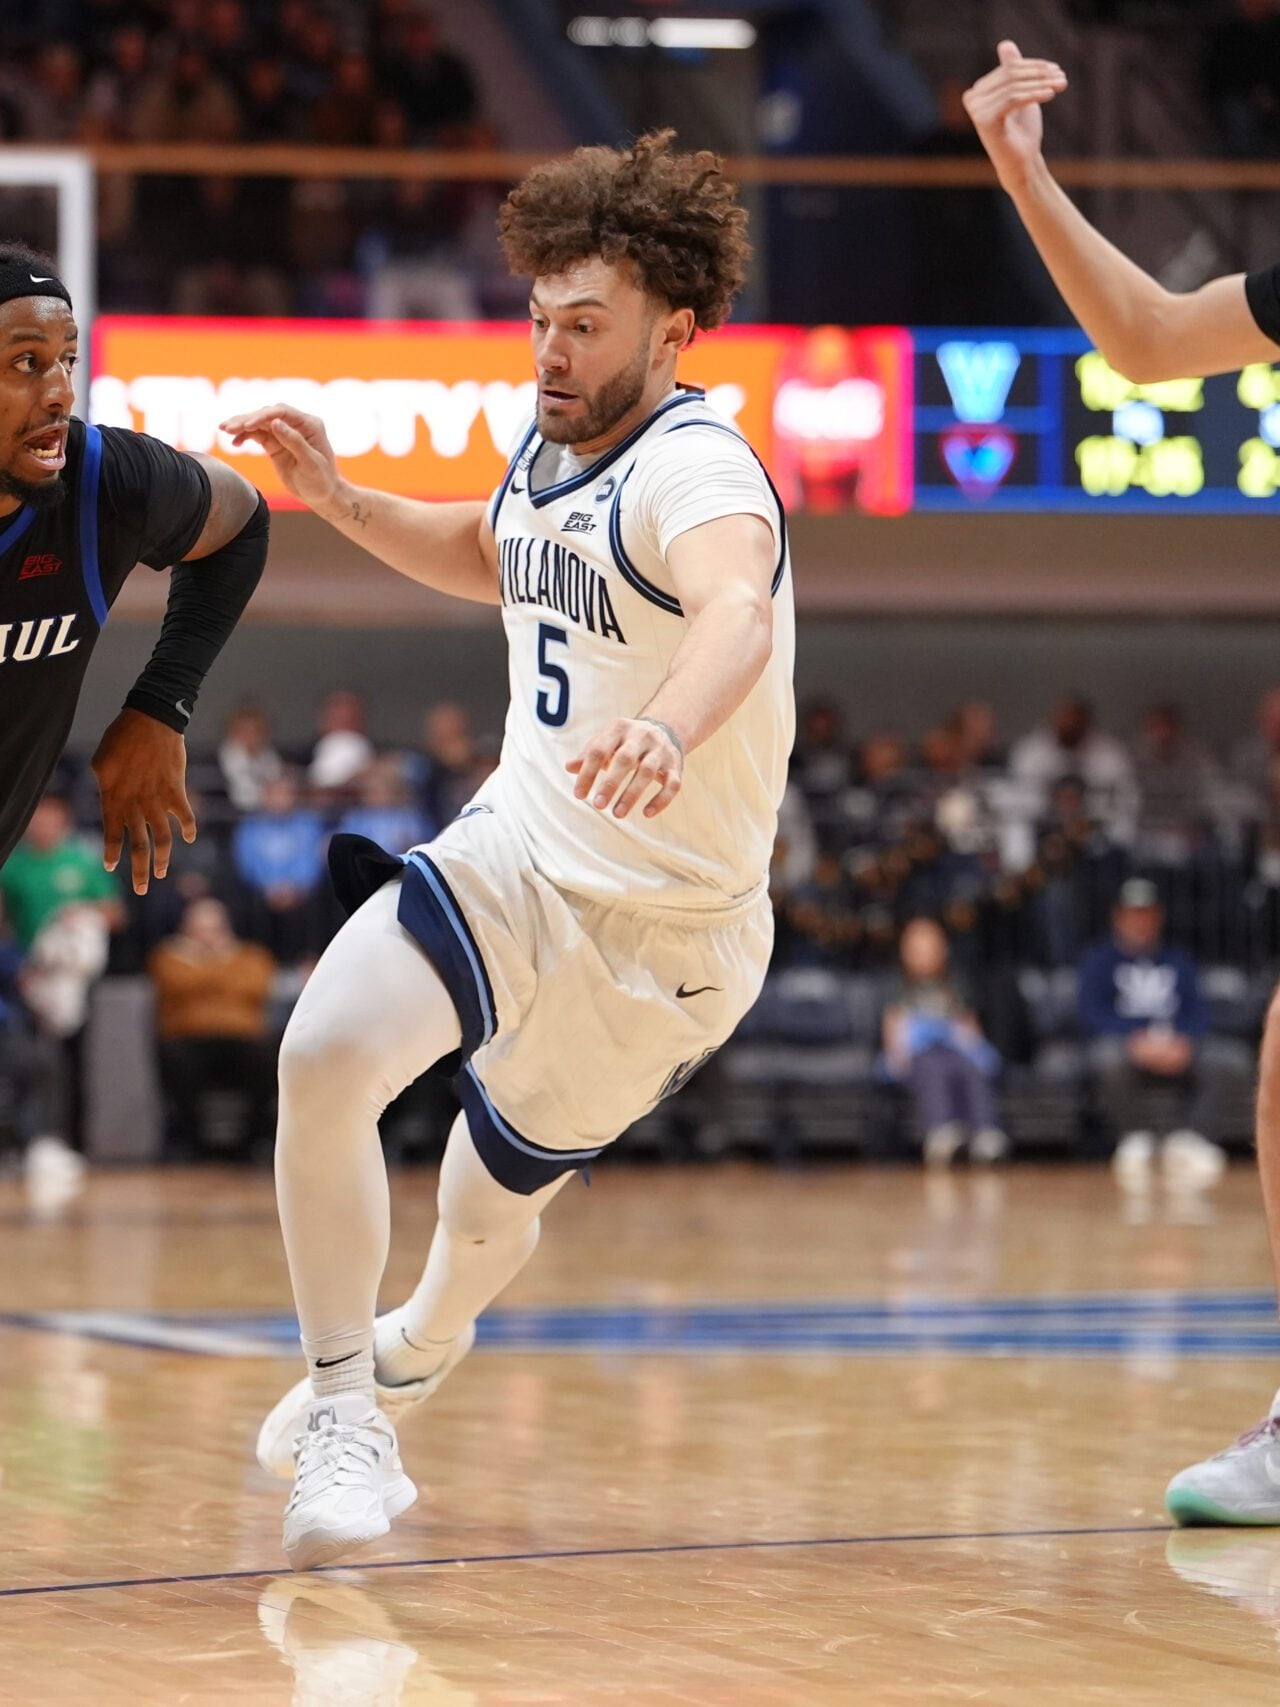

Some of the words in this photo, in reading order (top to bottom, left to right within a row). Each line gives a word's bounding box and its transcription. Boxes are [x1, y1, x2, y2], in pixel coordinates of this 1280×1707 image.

[569, 511, 593, 522] BIG
[564, 520, 596, 531] EAST
[536, 621, 569, 728] 5
